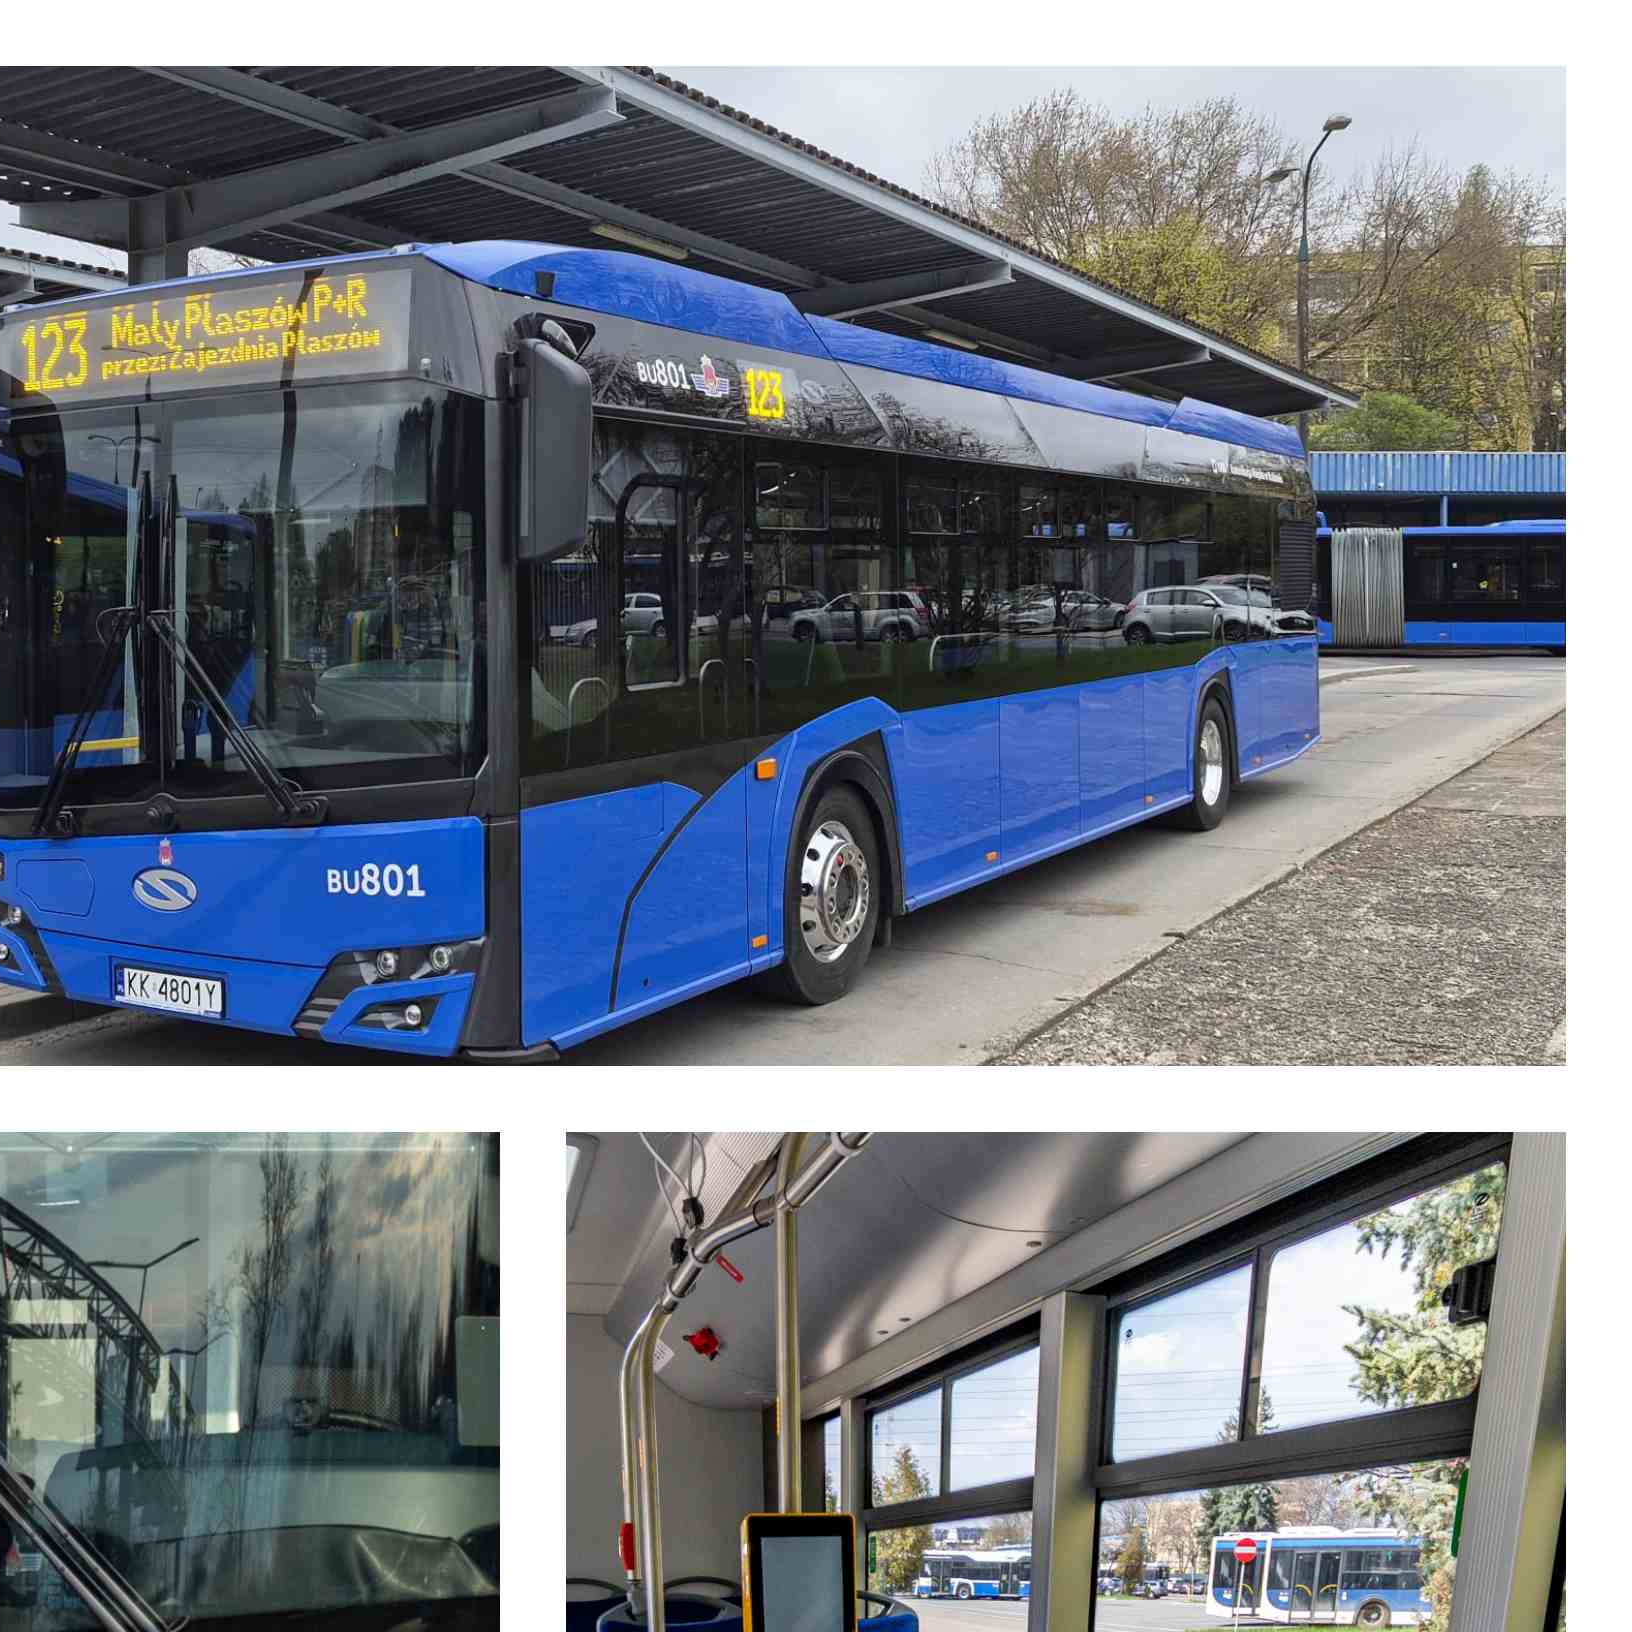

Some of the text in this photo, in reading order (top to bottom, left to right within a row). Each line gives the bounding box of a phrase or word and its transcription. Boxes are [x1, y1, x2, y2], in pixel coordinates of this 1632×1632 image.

[22, 316, 89, 392] 123
[312, 278, 367, 322] P+R
[636, 358, 691, 390] BU801
[745, 367, 785, 420] 123
[327, 863, 426, 897] BU801
[127, 971, 216, 1008] KK 4801Y
